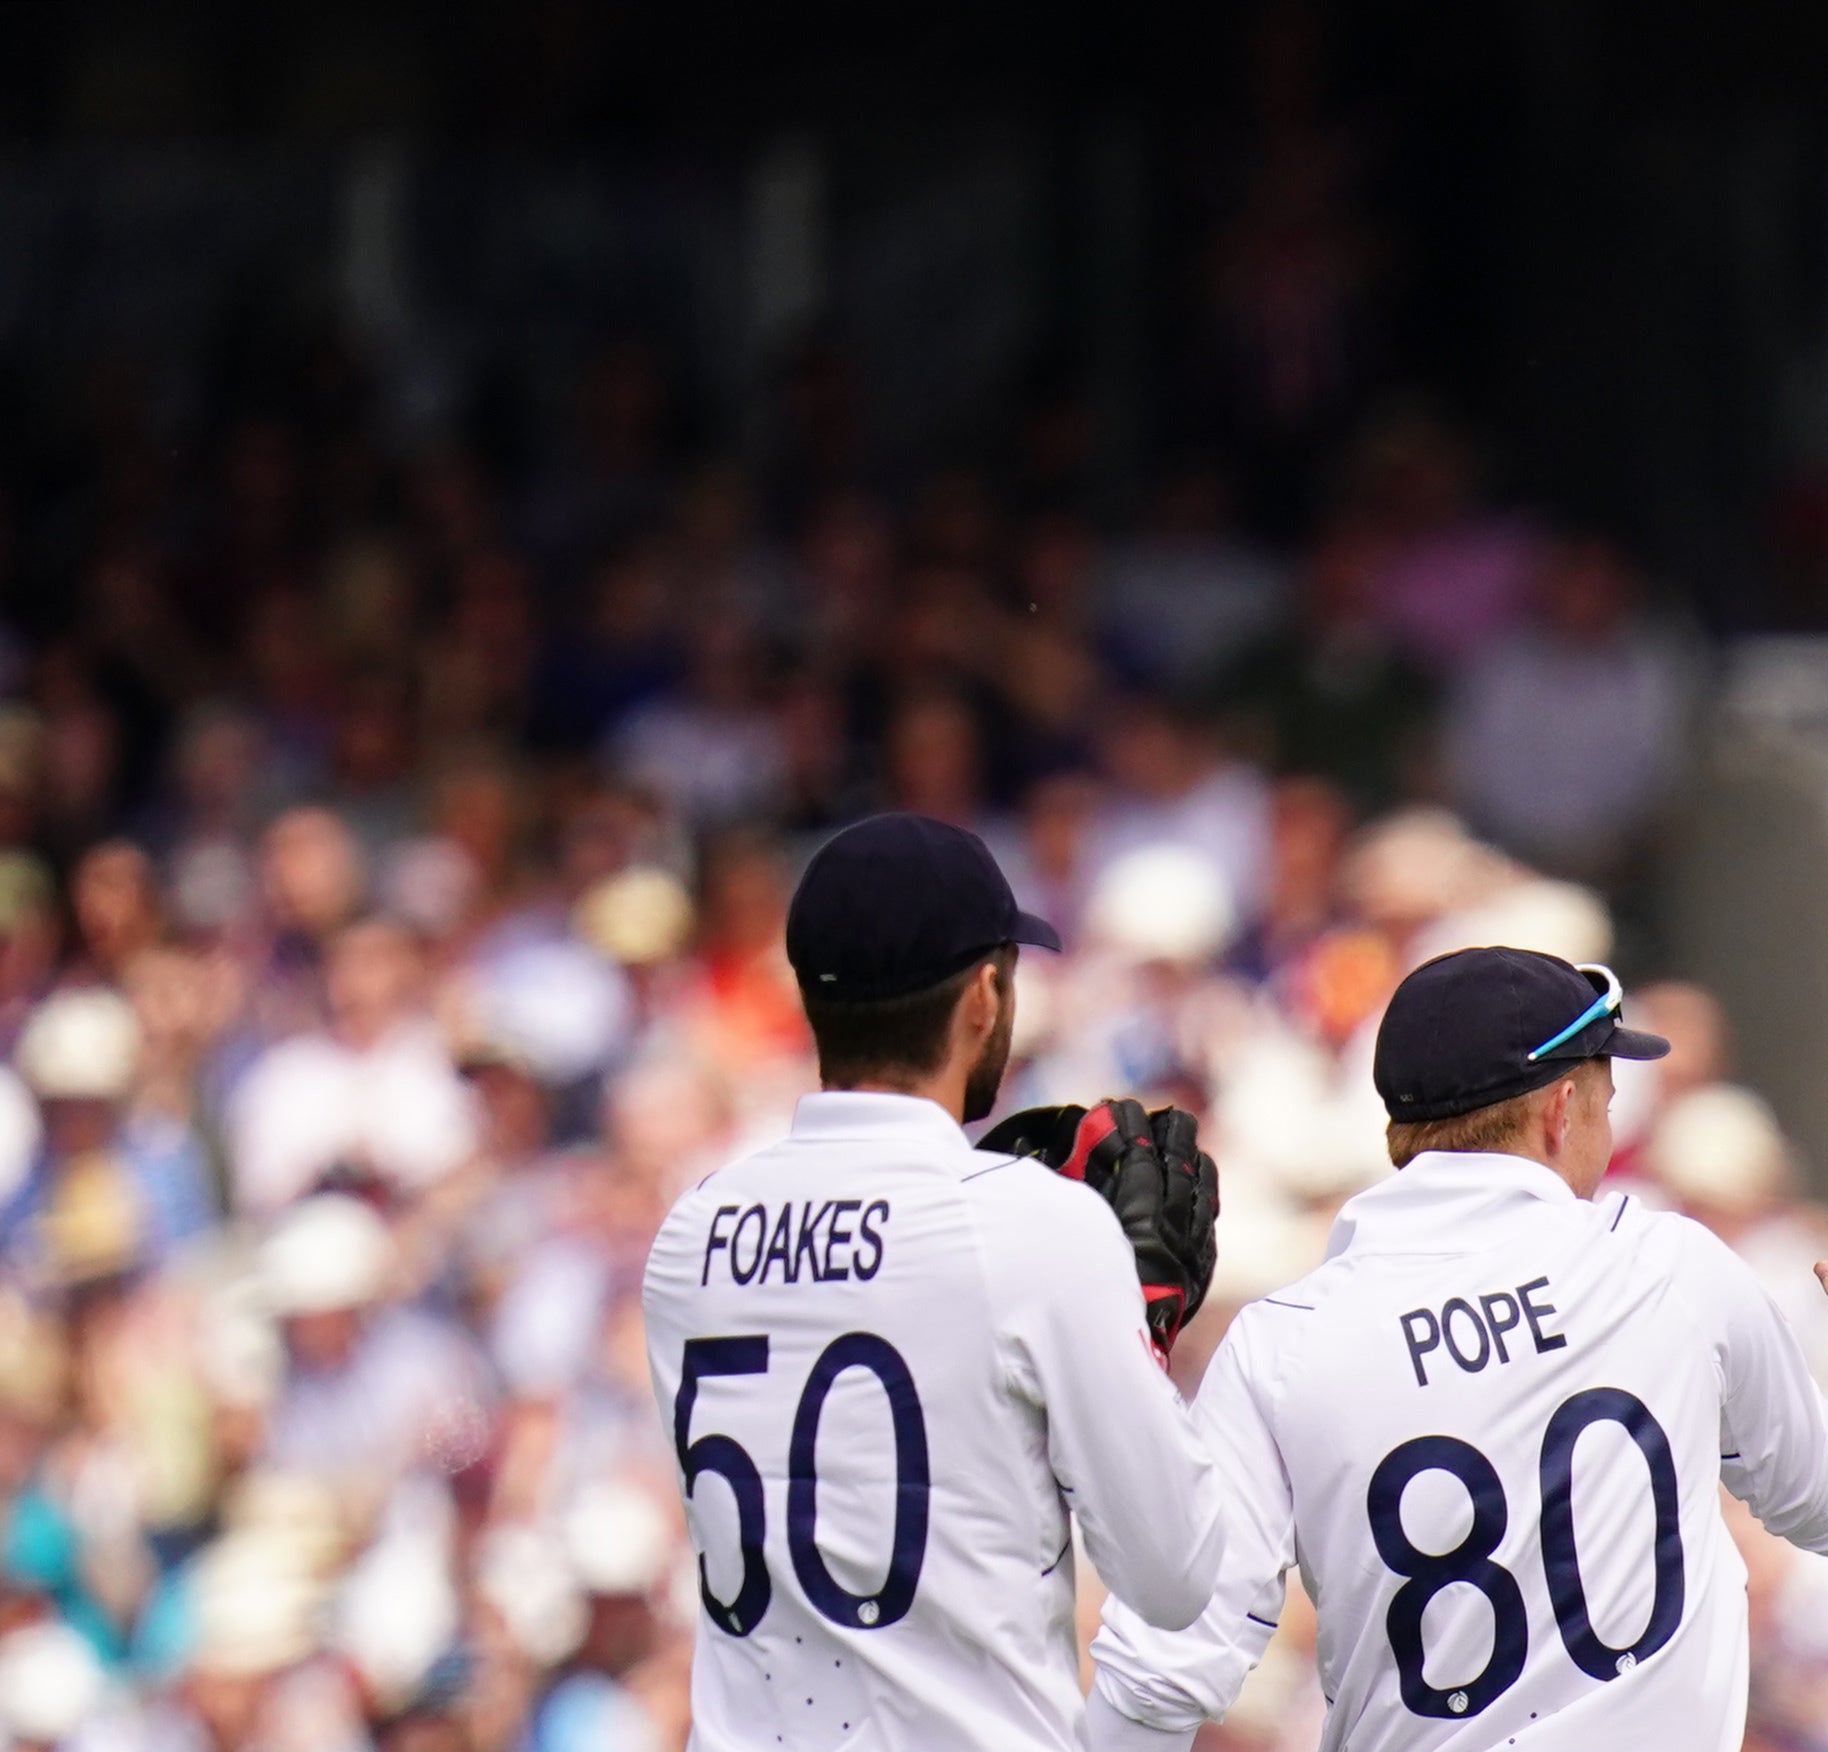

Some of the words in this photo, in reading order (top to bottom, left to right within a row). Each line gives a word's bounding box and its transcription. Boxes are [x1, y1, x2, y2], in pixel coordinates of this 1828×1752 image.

[701, 1200, 890, 1288] FOAKES
[1399, 1276, 1567, 1387] POPE
[674, 1331, 932, 1638] 50
[1367, 1386, 1686, 1720] 80
